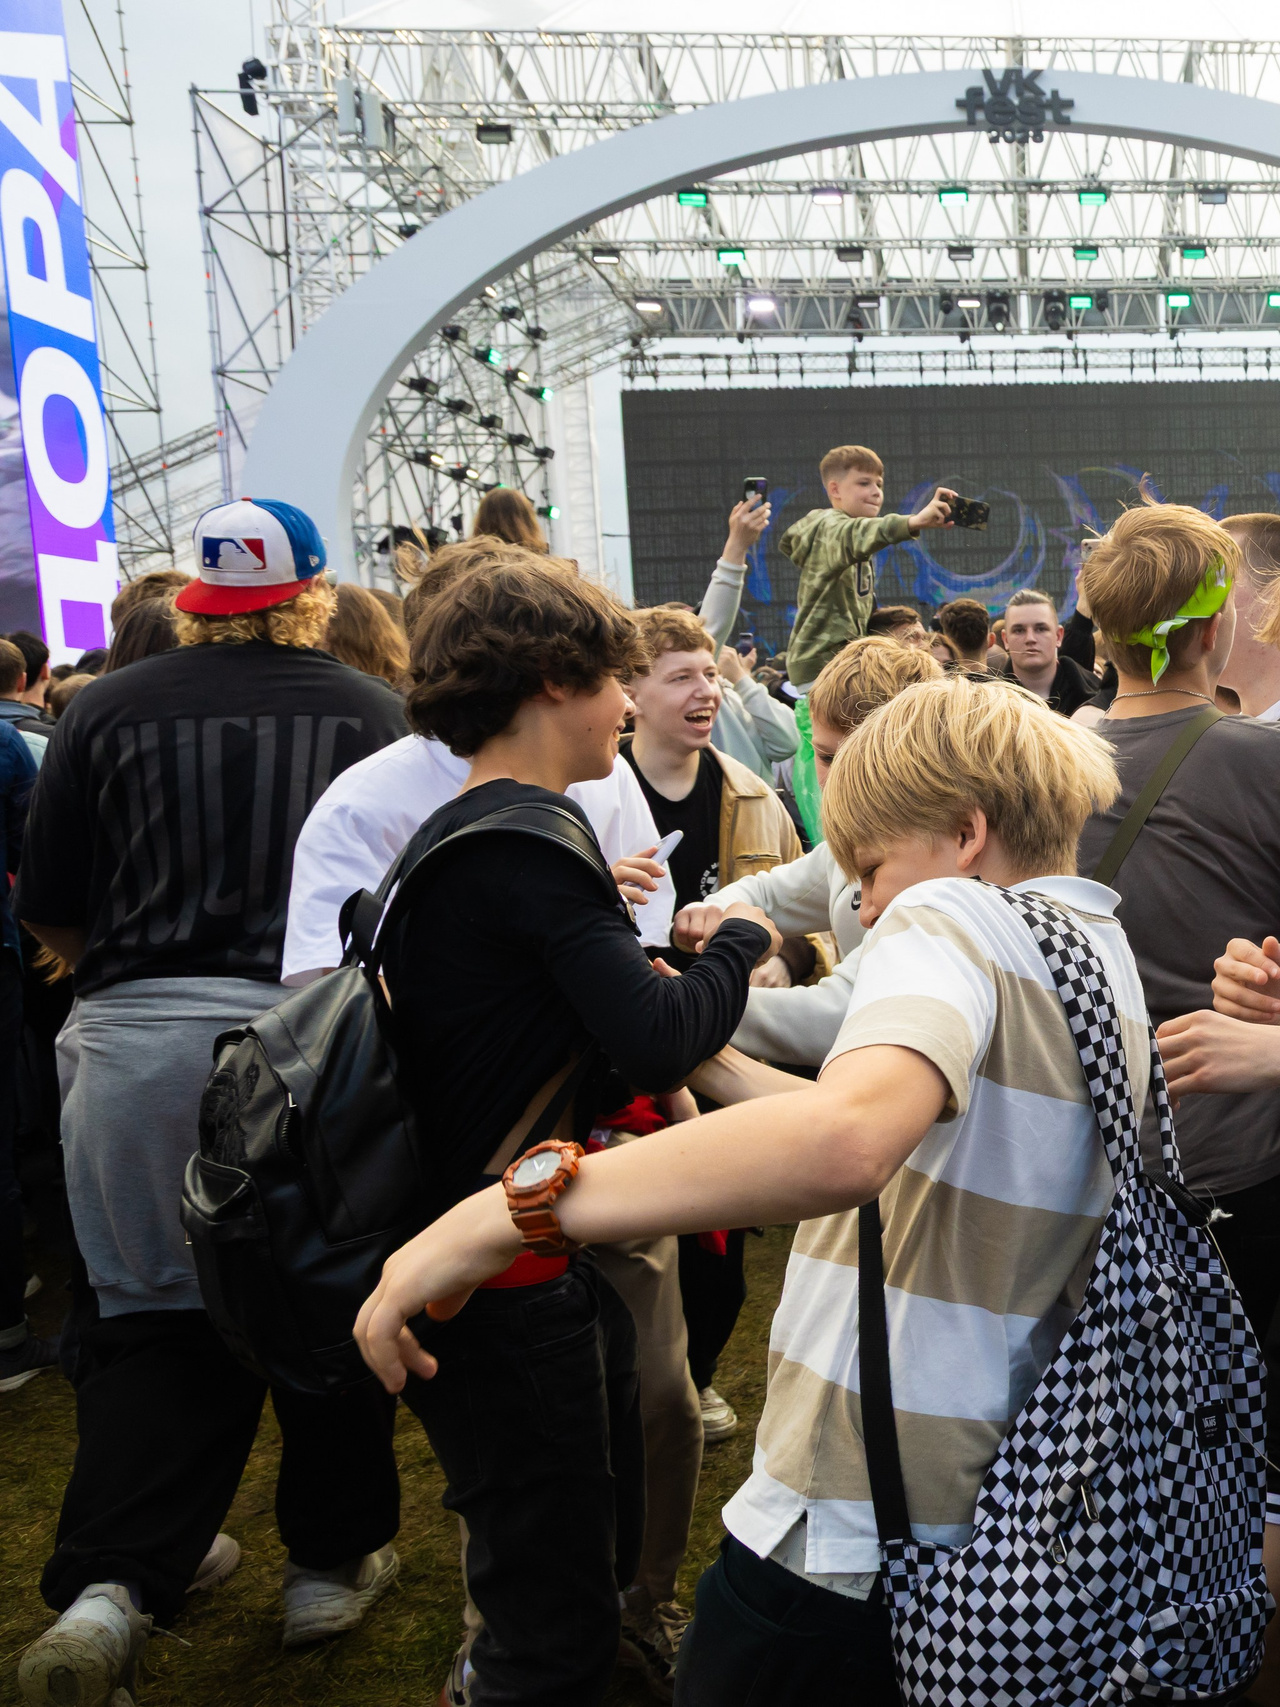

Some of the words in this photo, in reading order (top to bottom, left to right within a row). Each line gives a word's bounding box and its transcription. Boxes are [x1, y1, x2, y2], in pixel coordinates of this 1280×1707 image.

[981, 69, 1046, 96] VK
[955, 87, 1075, 126] fest
[0, 30, 119, 668] ДОРА
